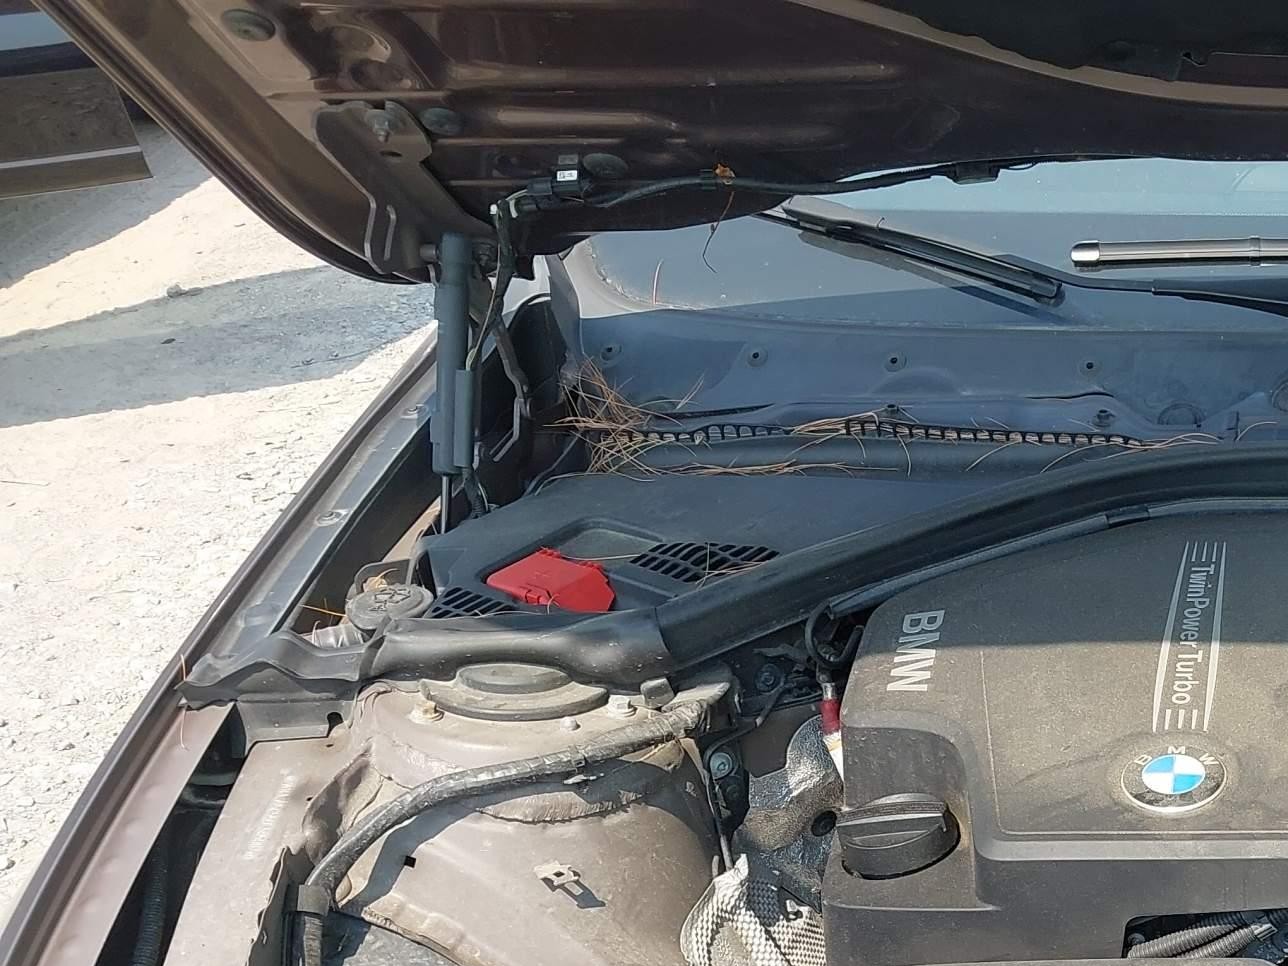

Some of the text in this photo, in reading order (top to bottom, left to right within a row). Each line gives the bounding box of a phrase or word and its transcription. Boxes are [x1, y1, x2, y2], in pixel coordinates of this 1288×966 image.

[886, 609, 945, 692] BMW
[1171, 650, 1203, 704] Turbo
[1133, 746, 1220, 766] BMW
